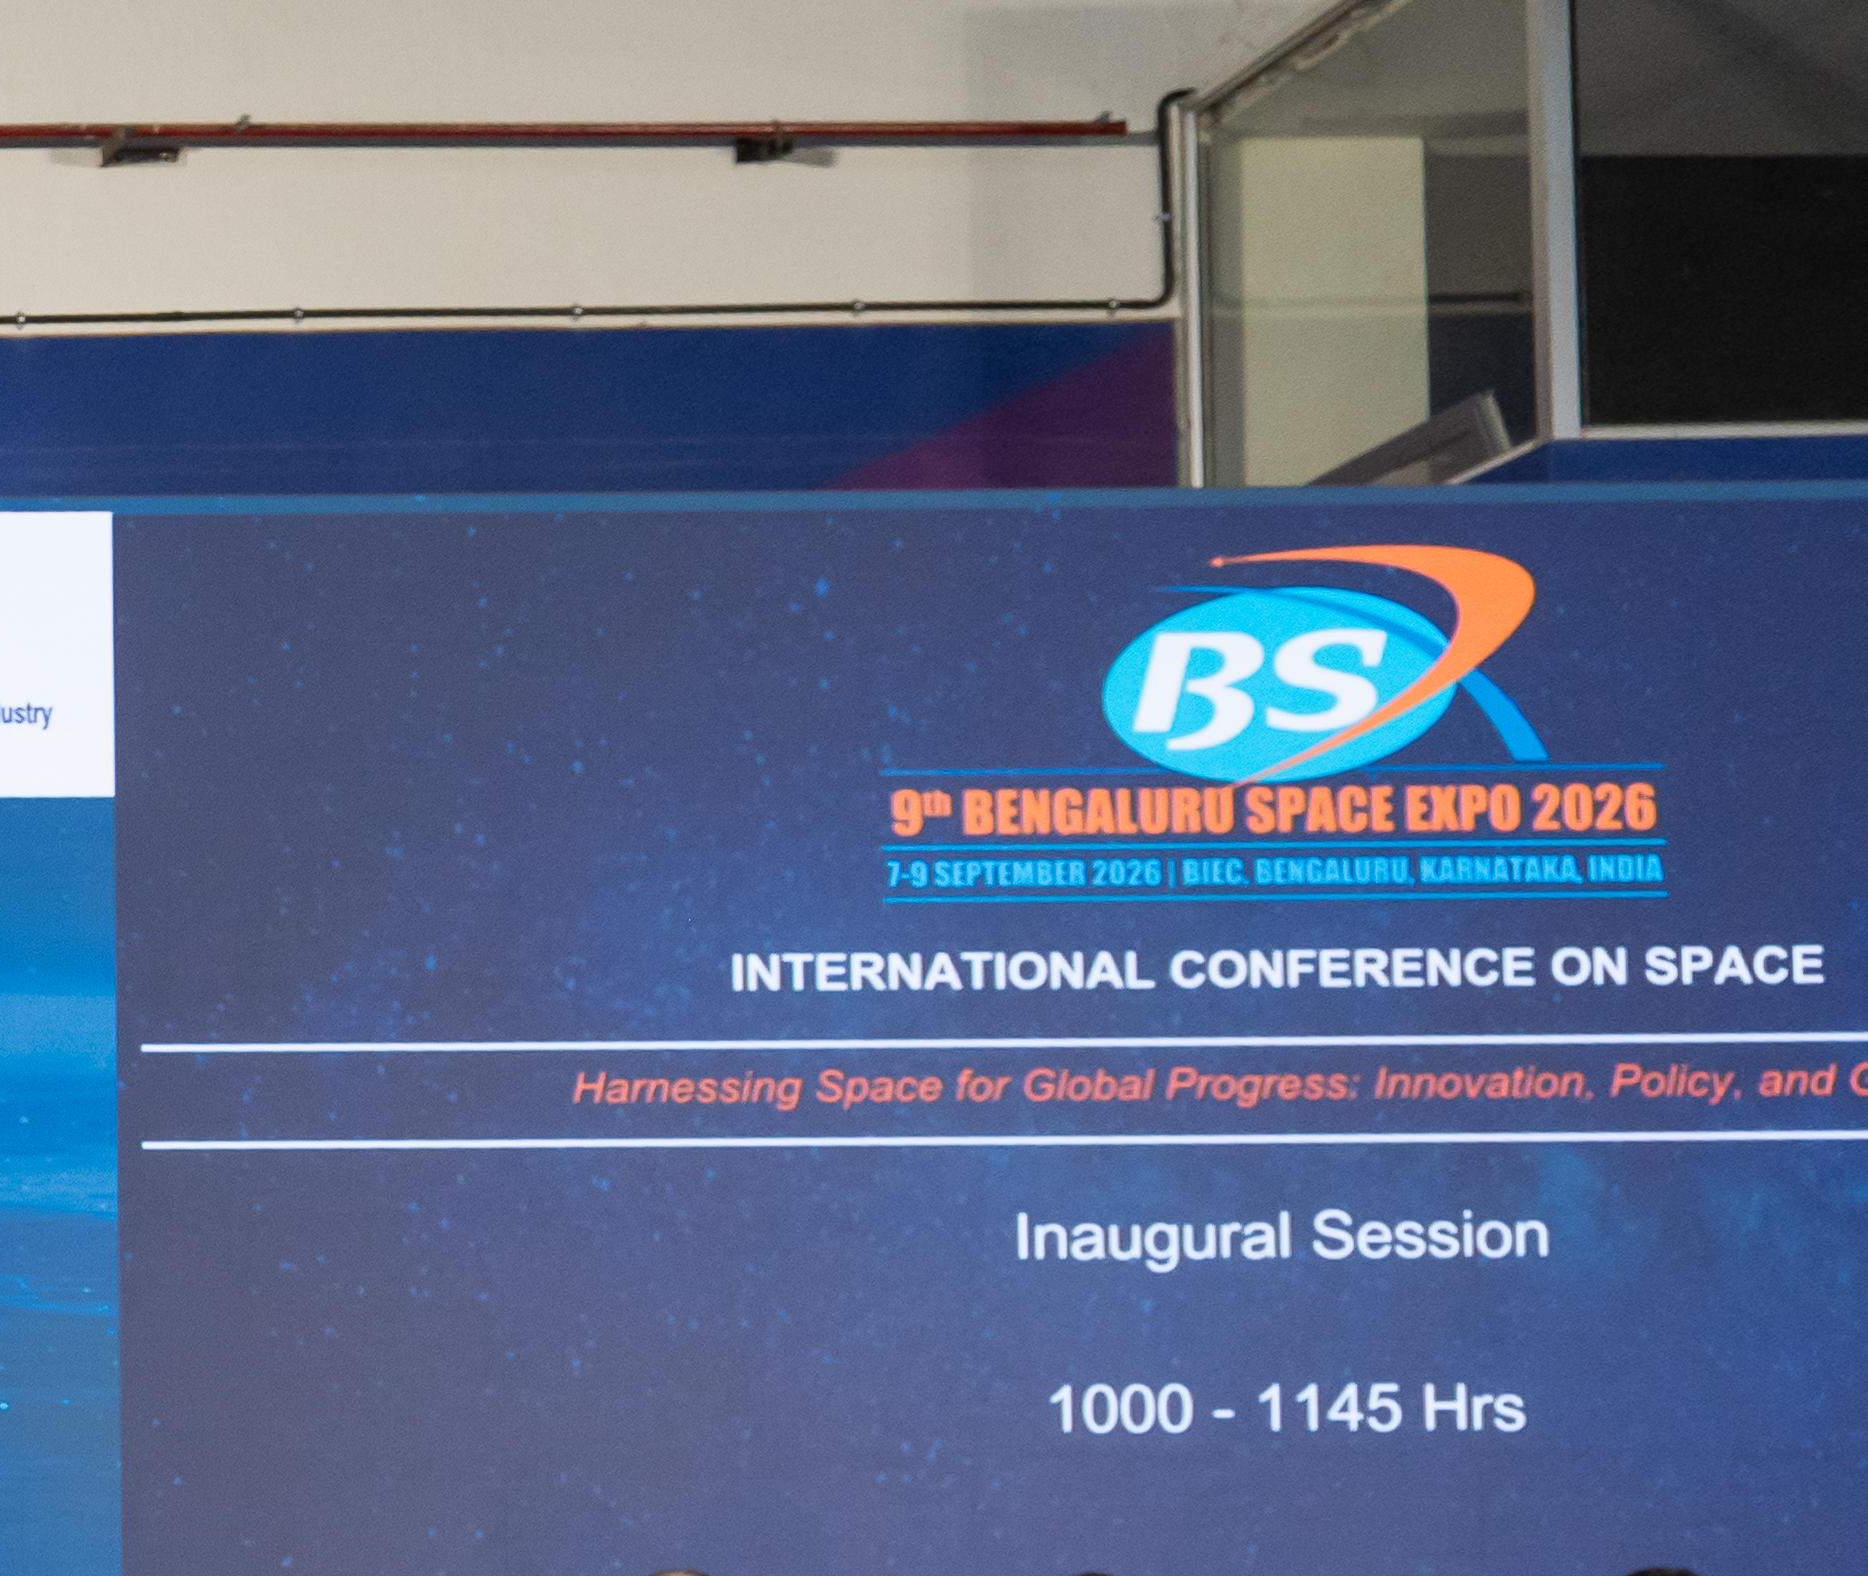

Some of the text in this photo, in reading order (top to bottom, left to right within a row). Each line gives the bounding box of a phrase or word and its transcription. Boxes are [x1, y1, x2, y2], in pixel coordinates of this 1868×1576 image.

[892, 782, 1657, 836] 9th BENGALURU SPACE EXPO 2026
[886, 854, 1664, 889] 7-9 SEPTEMBER 2026 BIEC, BENGALURU, KARNATAKA, INDIA
[732, 944, 1824, 992] INTERNATIONAL CONFERENCE ON SPACE
[573, 1071, 804, 1112] Harnessing
[816, 1068, 945, 1109] Space
[957, 1067, 1012, 1103] for
[1024, 1067, 1156, 1102] Global
[1166, 1065, 1360, 1109] Progress:
[1375, 1065, 1594, 1100] Innovation,
[1611, 1062, 1741, 1105] Policy,
[1759, 1063, 1838, 1098] and
[1017, 1208, 1549, 1273] Inaugural Session
[1050, 1383, 1194, 1434] 1000
[1259, 1382, 1403, 1433] 1145
[1424, 1383, 1526, 1432] Hrs
